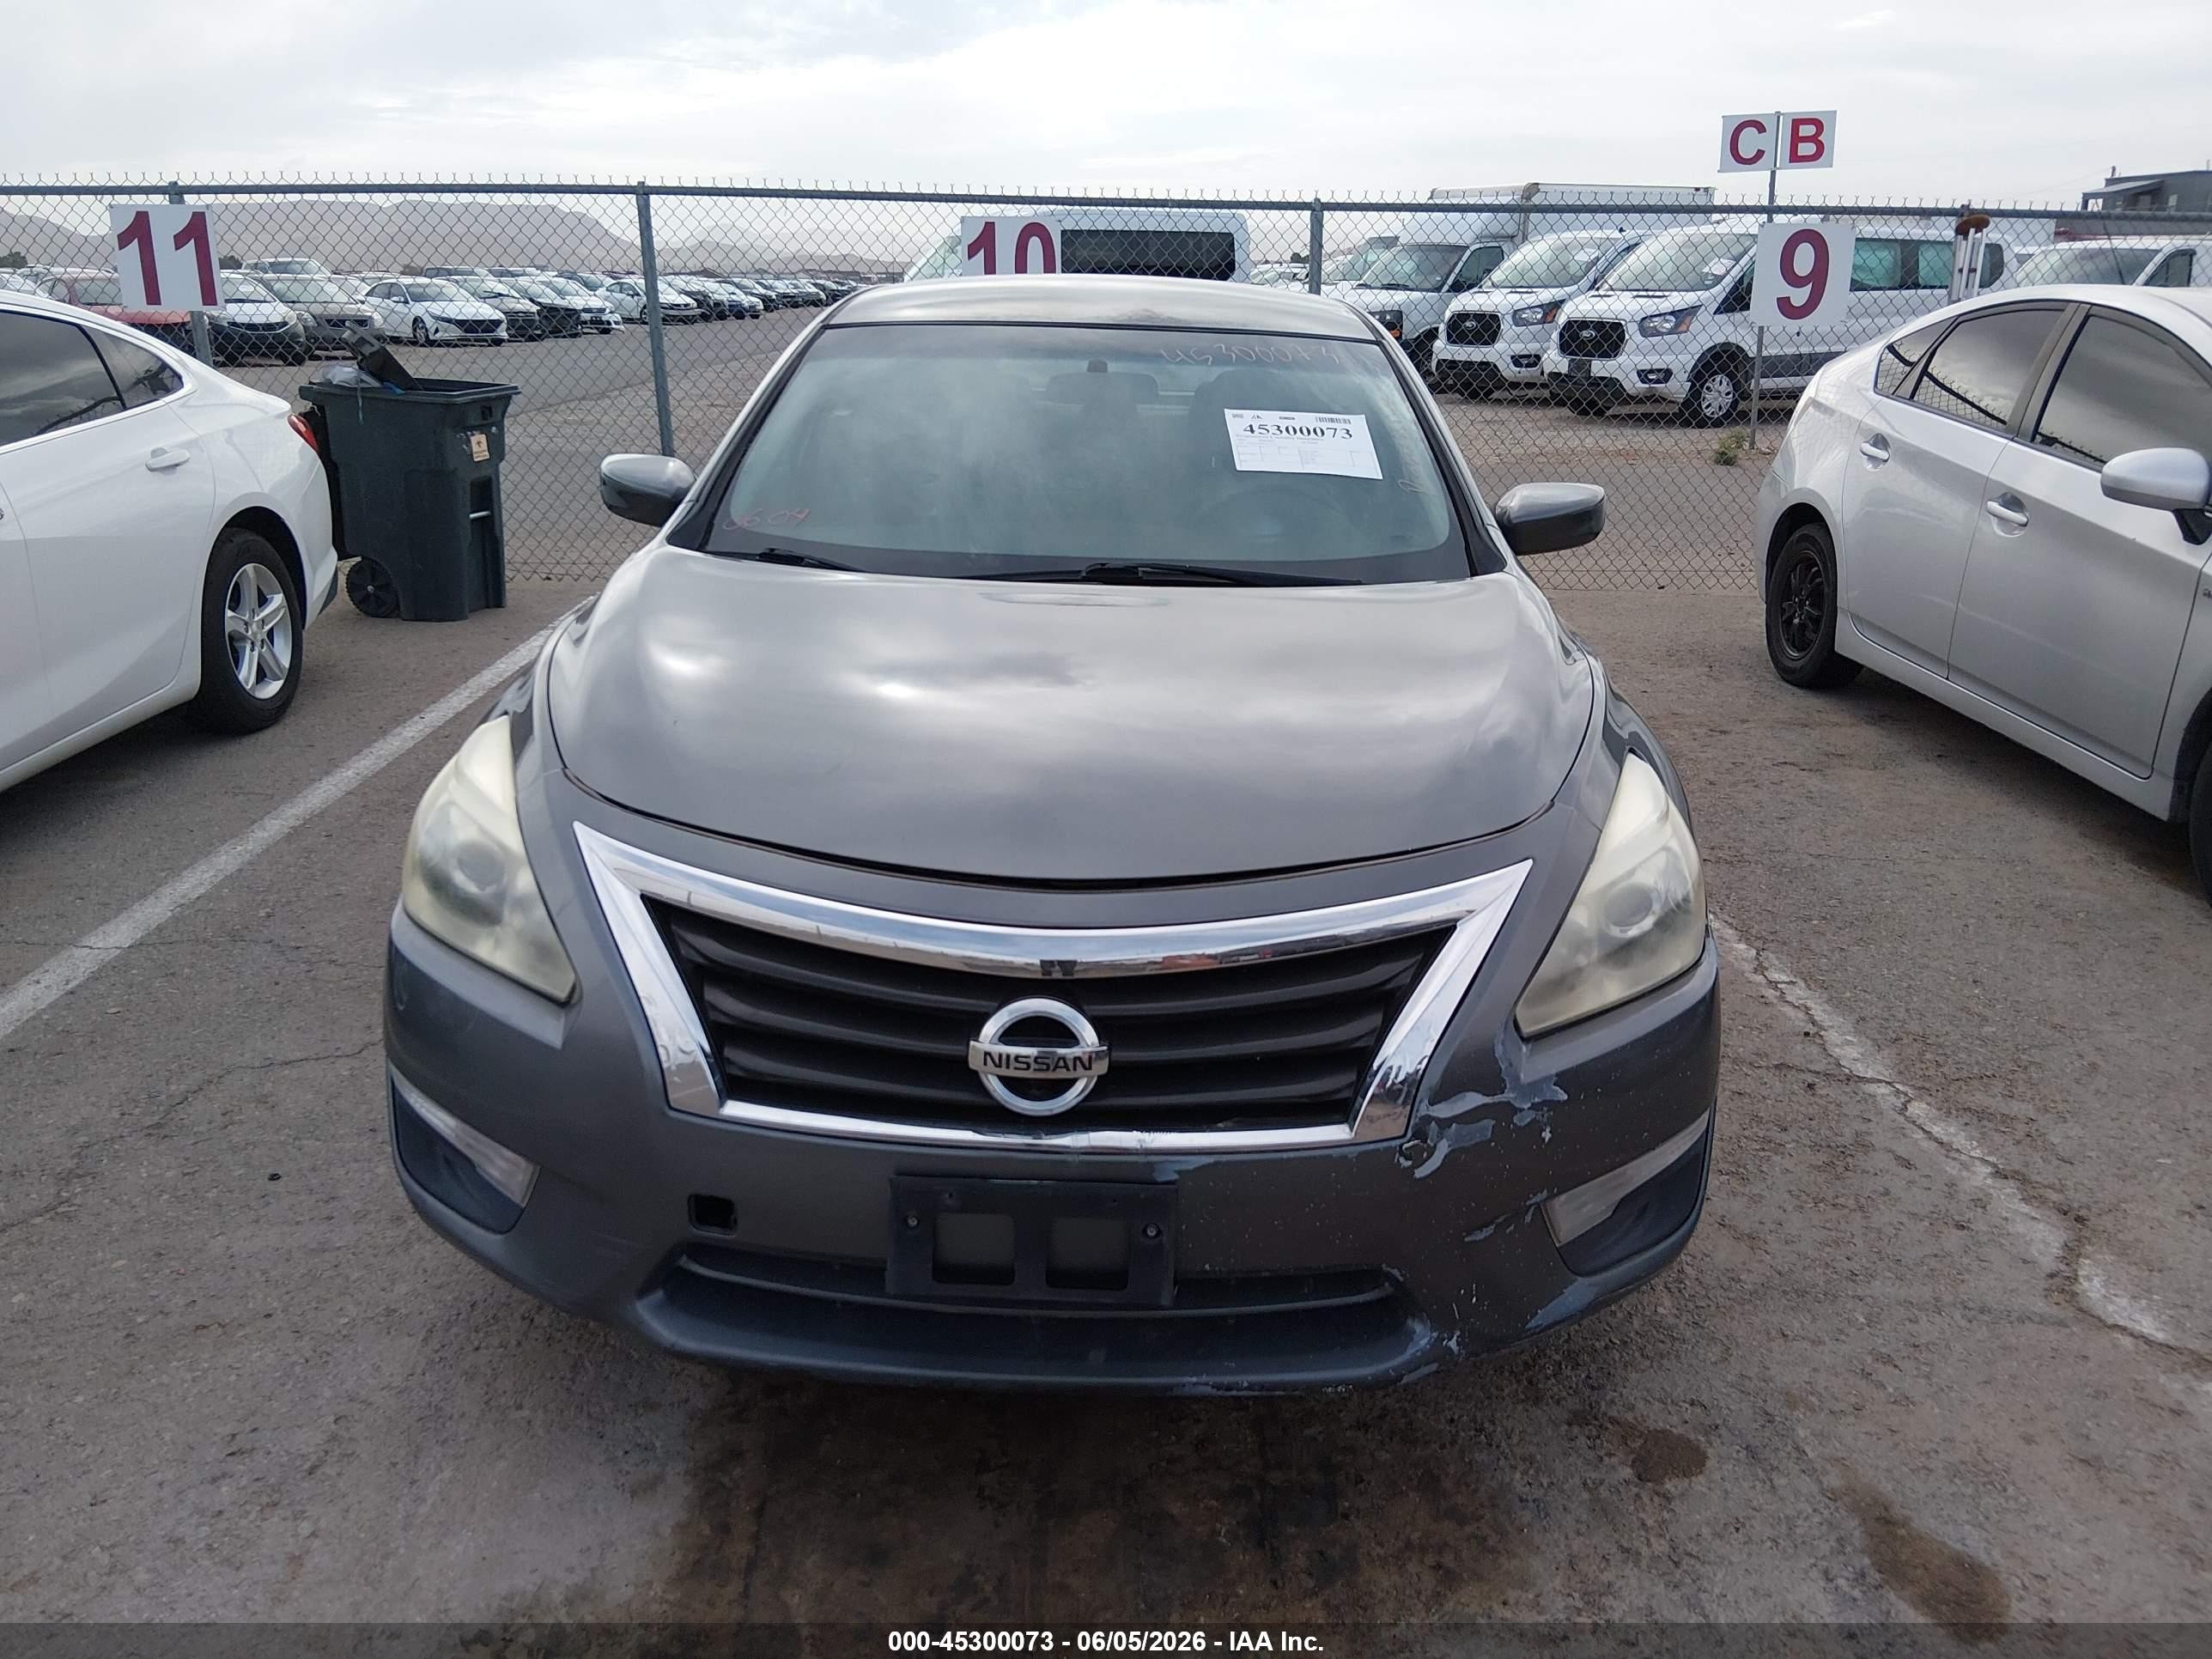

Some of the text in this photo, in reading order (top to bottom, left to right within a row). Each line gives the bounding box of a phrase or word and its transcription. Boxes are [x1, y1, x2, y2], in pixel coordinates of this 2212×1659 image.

[1729, 118, 1766, 166] C
[1788, 116, 1826, 164] B
[117, 210, 218, 307] 11
[967, 221, 1057, 276] 10
[1776, 228, 1830, 320] 9
[1243, 422, 1353, 441] 45300073
[982, 1051, 1094, 1073] NISSAN
